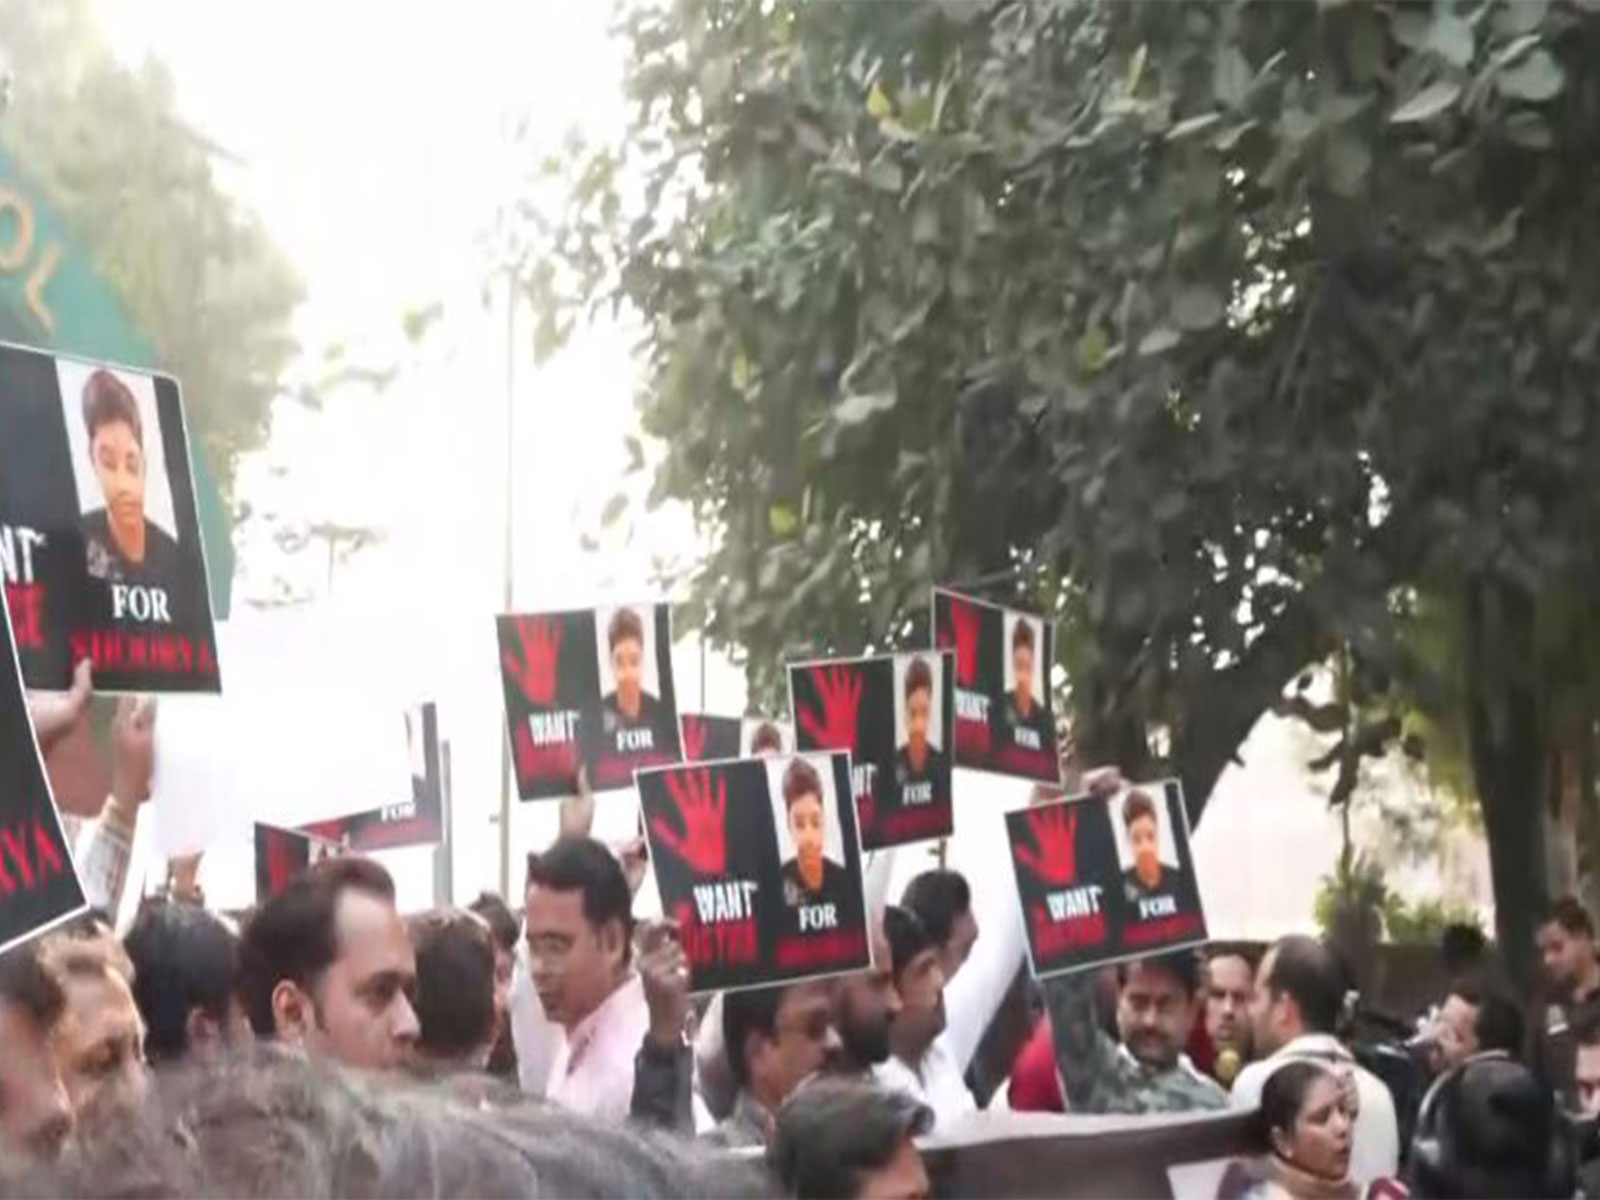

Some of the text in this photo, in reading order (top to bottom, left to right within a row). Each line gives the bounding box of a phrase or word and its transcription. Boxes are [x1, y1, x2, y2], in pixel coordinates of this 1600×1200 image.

[111, 583, 171, 622] FOR
[528, 710, 580, 747] WANT
[616, 728, 654, 752] FOR
[692, 882, 758, 925] WANT
[798, 903, 838, 933] FOR
[1046, 885, 1103, 923] WANT
[1138, 894, 1178, 921] FOR
